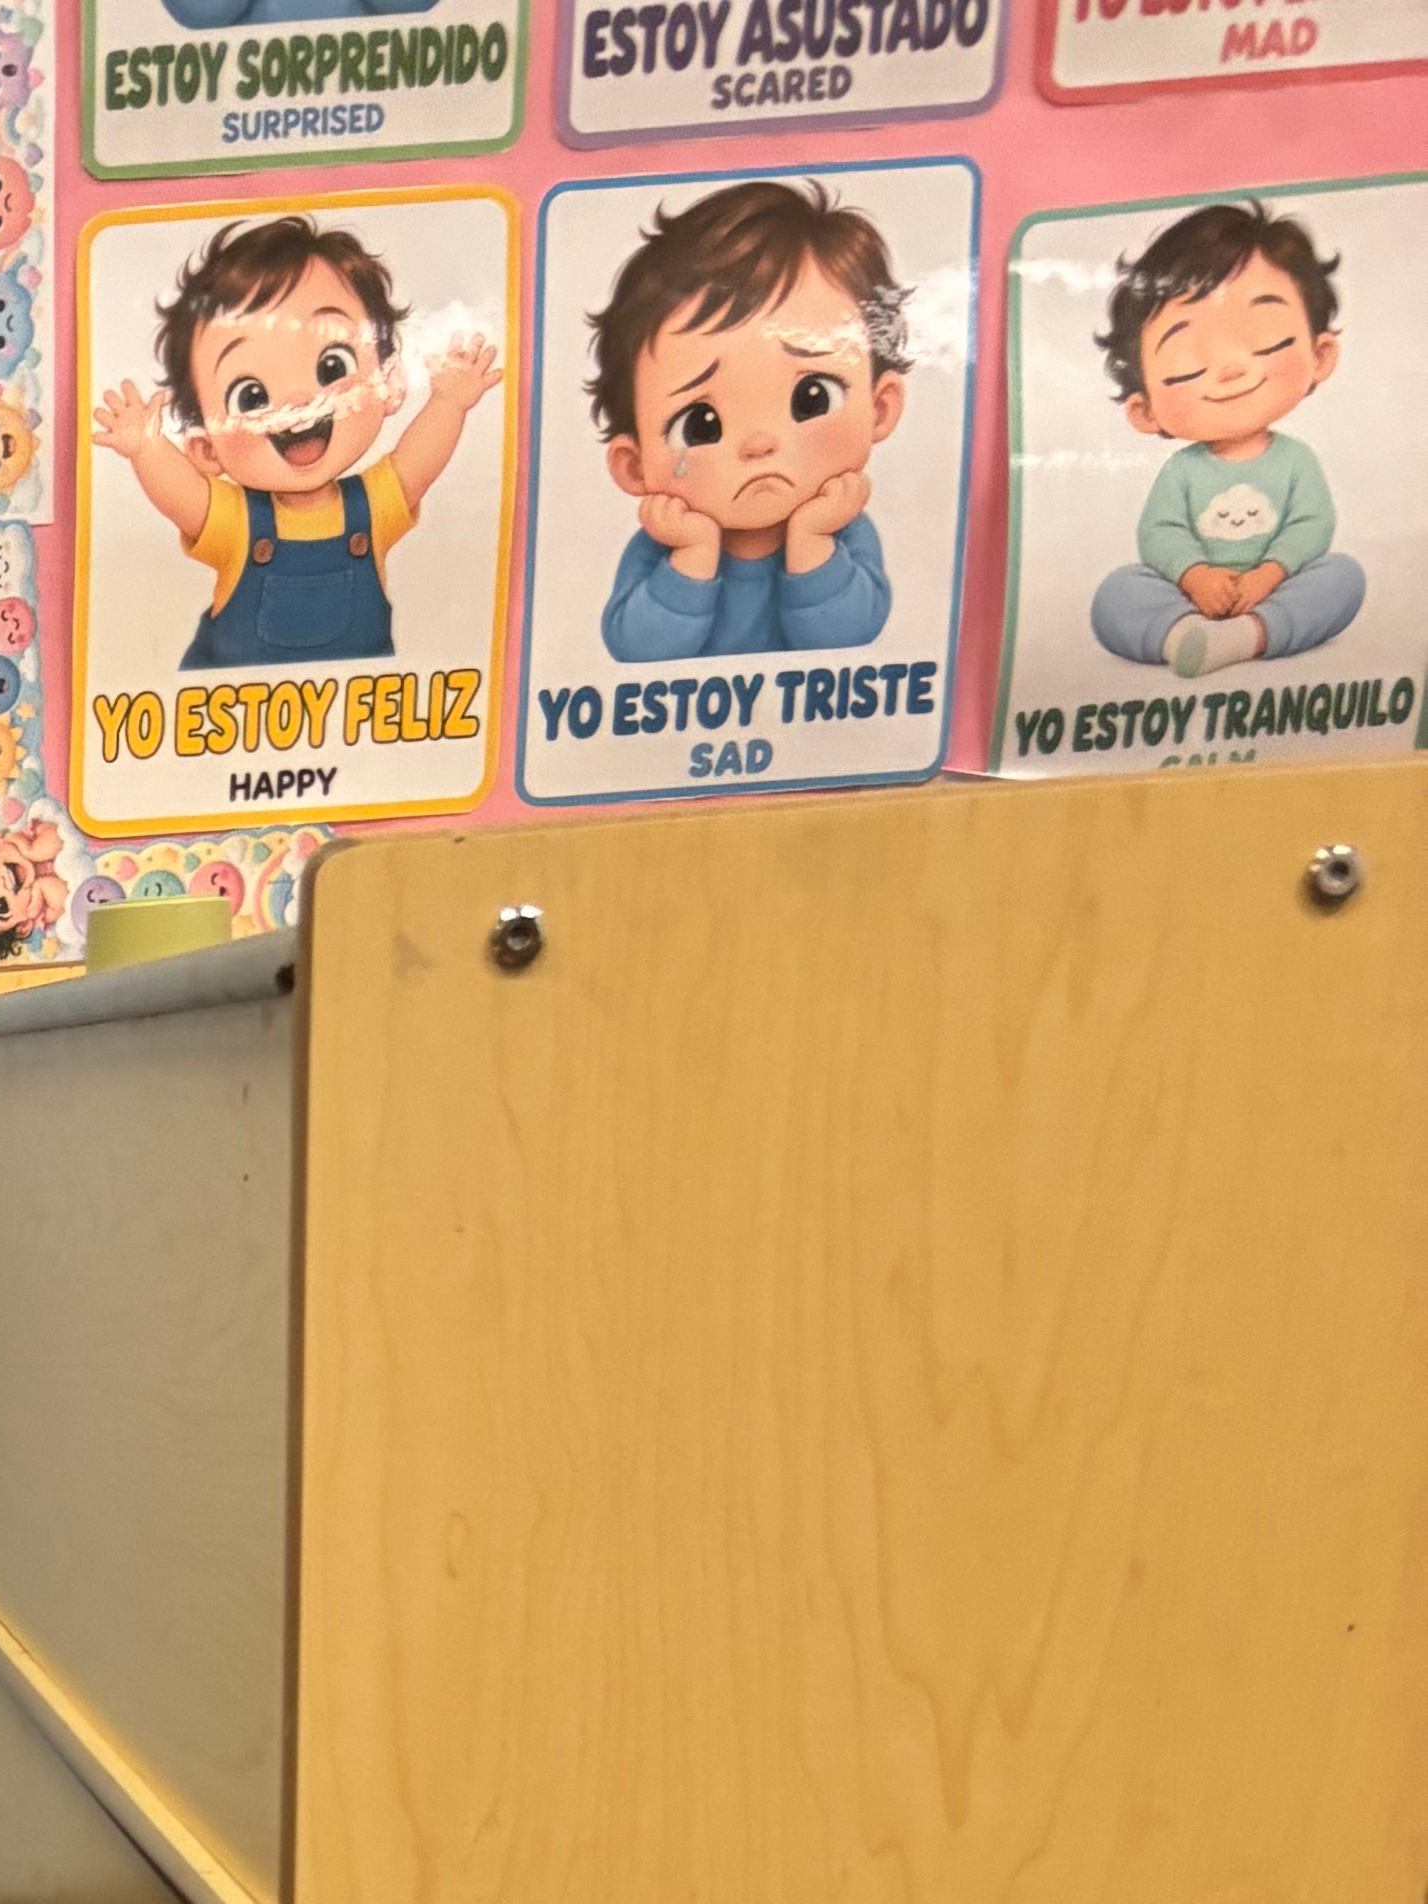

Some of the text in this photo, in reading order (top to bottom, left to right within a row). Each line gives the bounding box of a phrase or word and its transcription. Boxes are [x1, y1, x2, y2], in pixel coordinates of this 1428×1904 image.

[104, 20, 509, 111] ESTOY SORPRENDIDO
[584, 0, 990, 78] ESTOY ASUSTADO
[1220, 16, 1319, 63] MAD
[710, 64, 853, 110] SCARED
[221, 103, 386, 145] SURPRISED
[93, 669, 481, 764] YO ESTOY FELIZ
[538, 661, 939, 741] YO ESTOY TRISTE
[1015, 676, 1415, 757] YO ESTOY TRANQUILO
[229, 768, 338, 802] HAPPY
[689, 738, 774, 778] SAD
